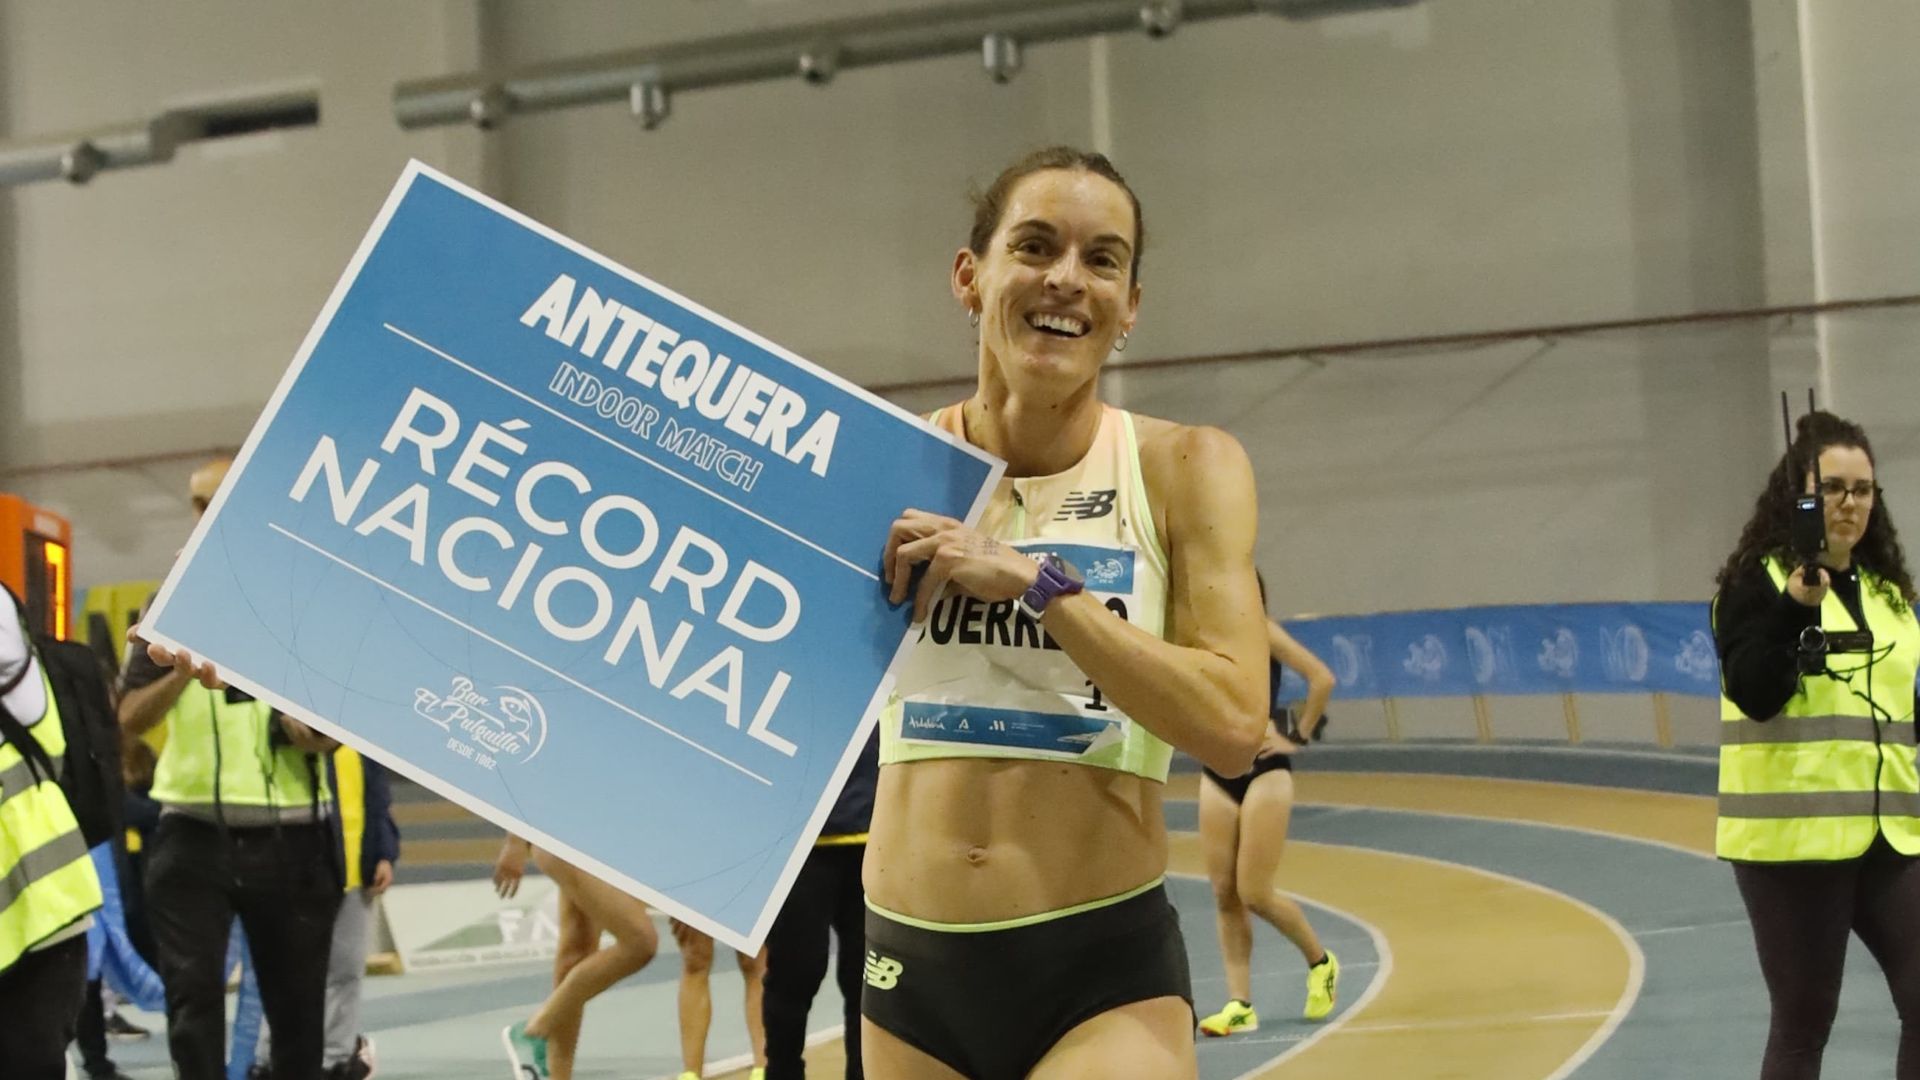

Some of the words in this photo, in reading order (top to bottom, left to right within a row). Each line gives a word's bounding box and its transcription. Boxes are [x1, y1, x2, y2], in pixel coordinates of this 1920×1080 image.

[520, 273, 841, 477] ANTEQUERA
[549, 361, 659, 439] INDOOR
[656, 417, 763, 492] MATCH
[380, 386, 801, 642] RÉCORD
[288, 434, 798, 758] NACIONAL
[441, 700, 521, 755] Pulguilla
[446, 736, 475, 759] DESDE
[447, 676, 490, 707] Bar
